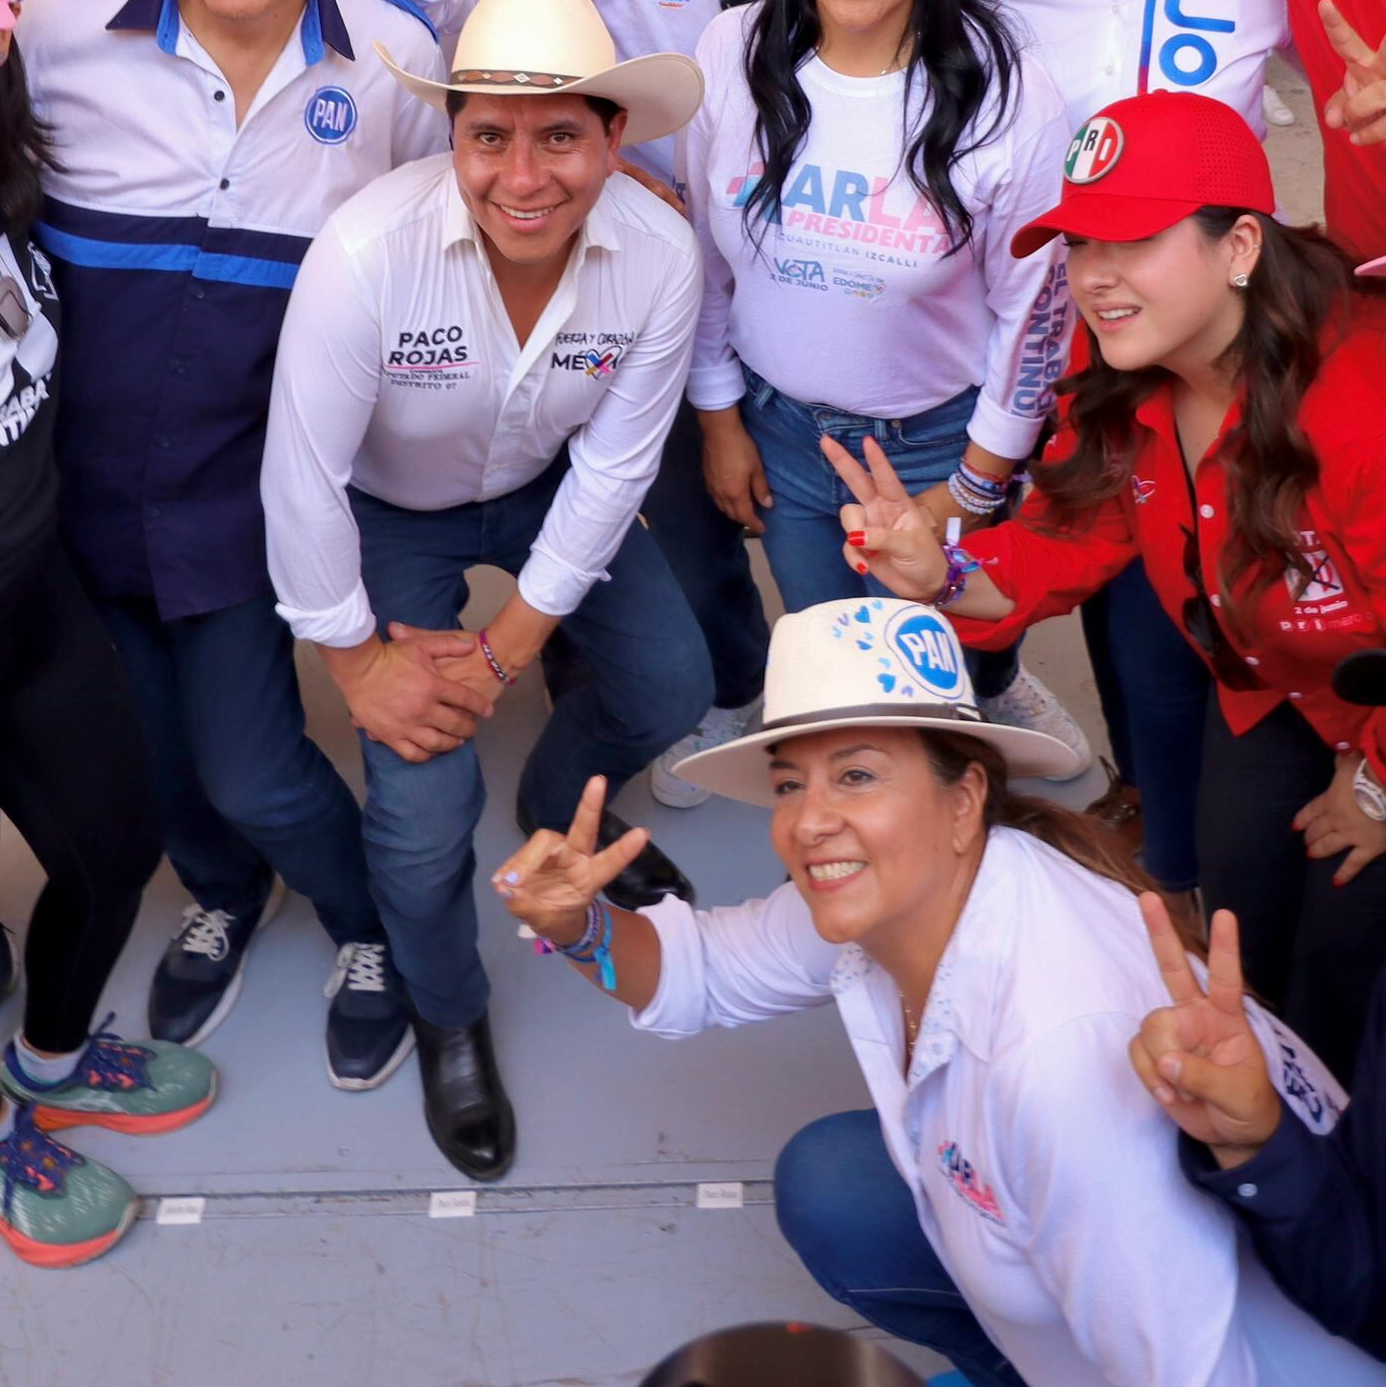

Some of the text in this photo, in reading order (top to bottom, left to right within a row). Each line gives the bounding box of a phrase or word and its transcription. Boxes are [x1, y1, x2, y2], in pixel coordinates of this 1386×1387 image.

[313, 98, 347, 132] PAN
[1066, 129, 1113, 162] PRI
[787, 210, 951, 254] PRESIDENTA
[865, 251, 917, 268] IZCALLI
[776, 274, 794, 285] DE
[796, 277, 829, 292] JUNIO
[1053, 263, 1069, 296] EL
[398, 325, 462, 348] PACO
[388, 346, 468, 365] ROJAS
[1304, 606, 1318, 614] de
[899, 629, 956, 674] PAN
